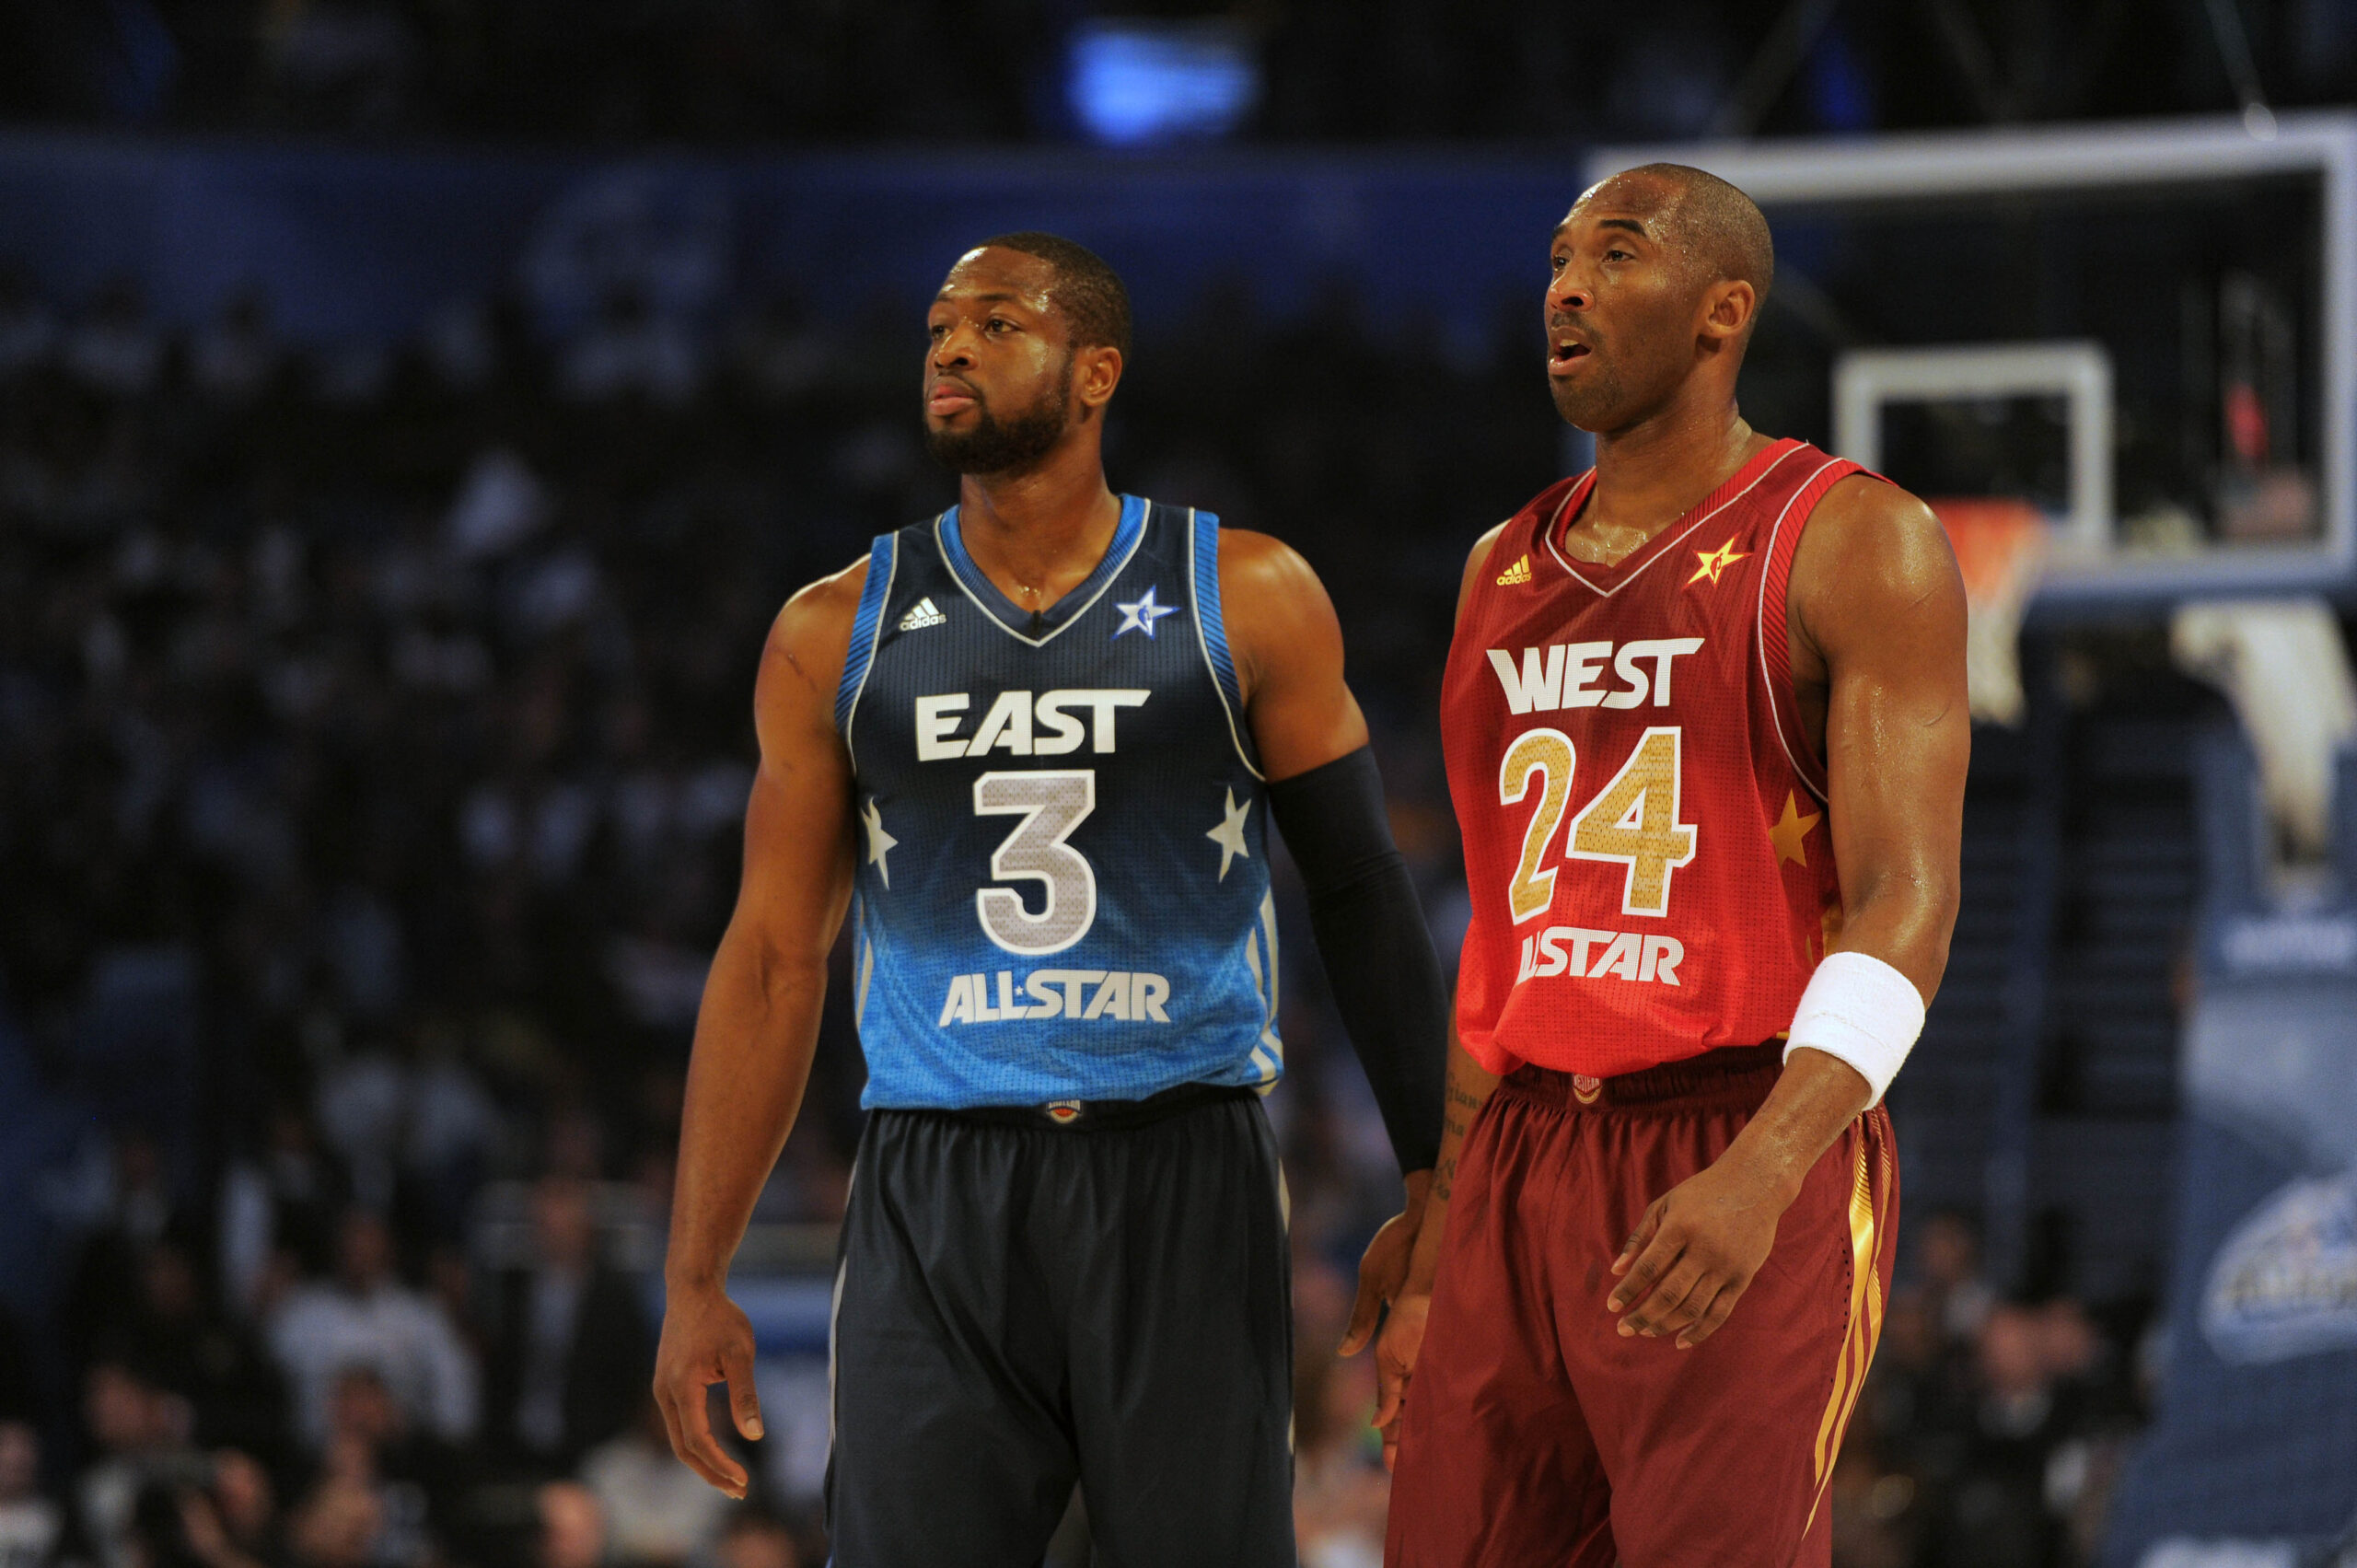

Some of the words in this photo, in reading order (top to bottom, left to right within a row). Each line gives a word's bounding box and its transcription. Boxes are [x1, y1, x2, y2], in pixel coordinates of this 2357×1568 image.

[1496, 573, 1532, 586] adidas
[900, 614, 946, 632] adidas
[1486, 638, 1705, 714] WEST
[916, 690, 1151, 761] EAST
[1499, 726, 1698, 925] 24
[973, 770, 1097, 956] 3
